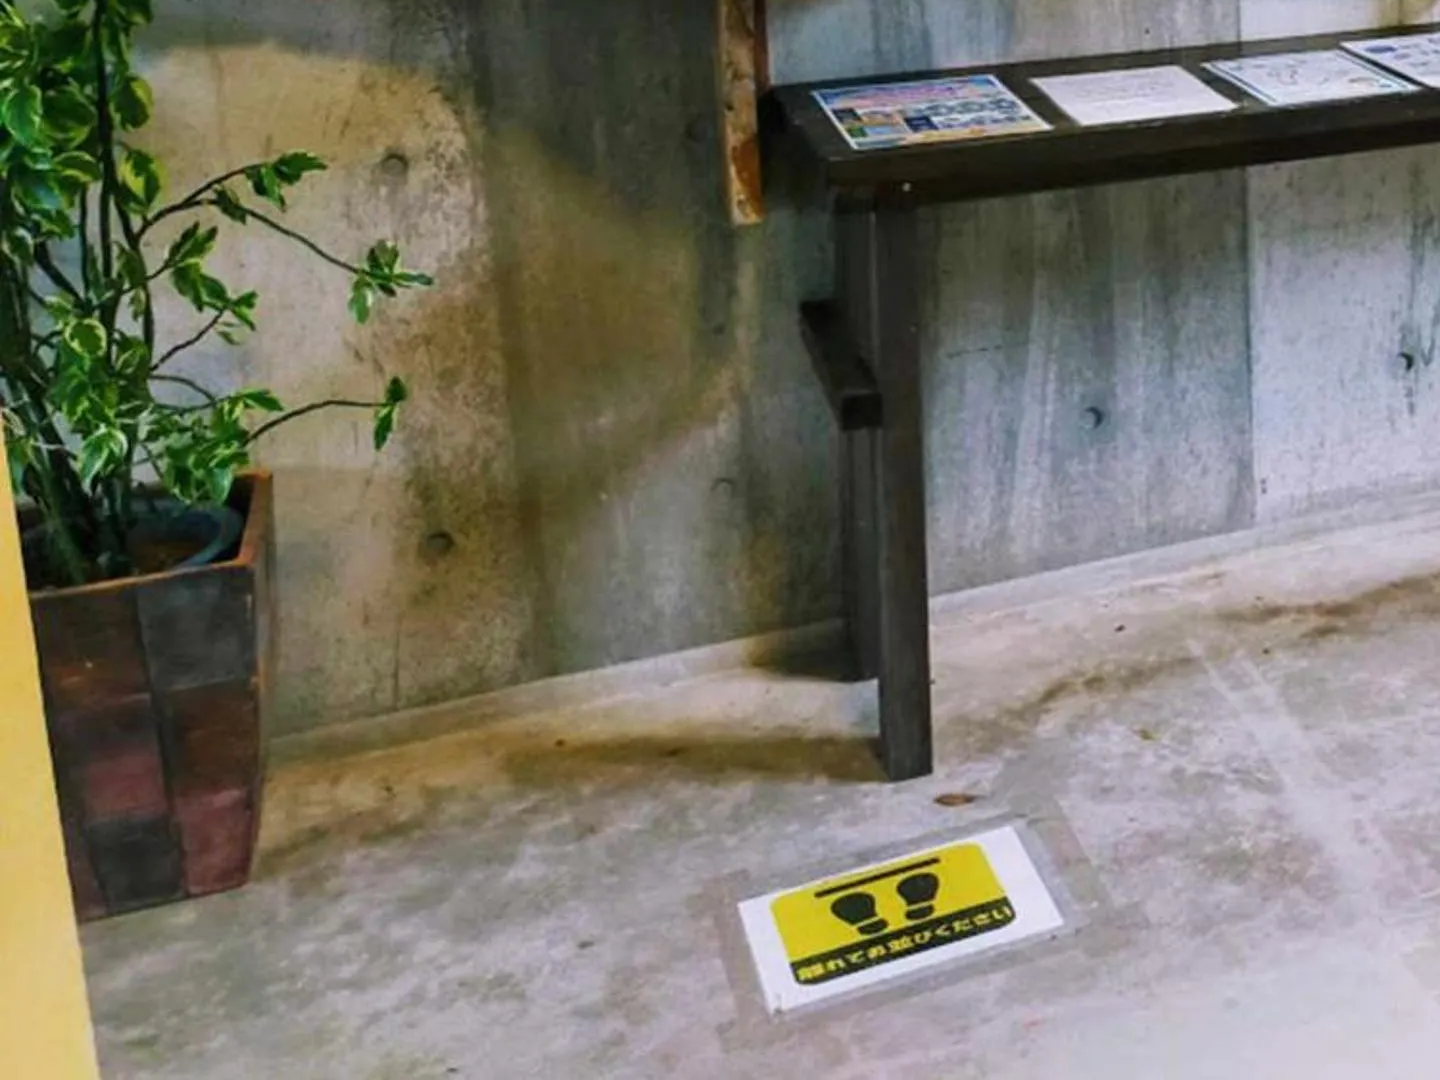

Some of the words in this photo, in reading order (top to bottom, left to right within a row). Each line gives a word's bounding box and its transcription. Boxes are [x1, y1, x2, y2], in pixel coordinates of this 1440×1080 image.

[797, 906, 1012, 980] 離れてお並びください
